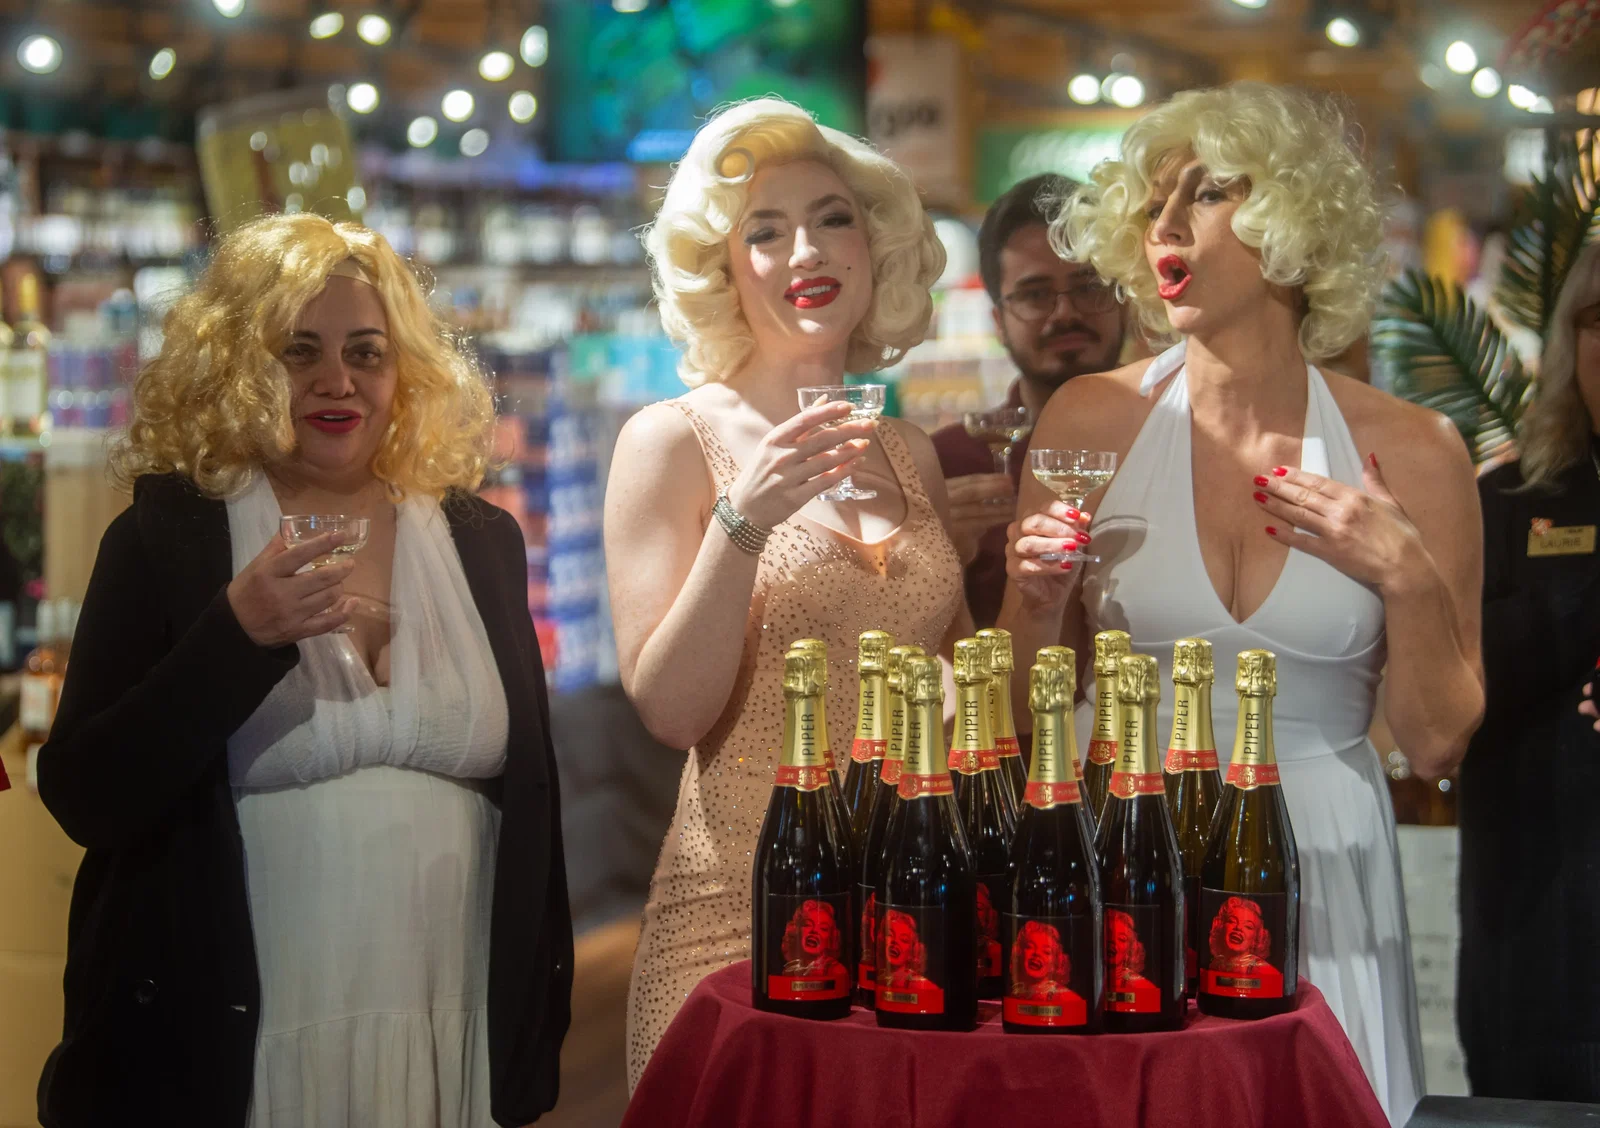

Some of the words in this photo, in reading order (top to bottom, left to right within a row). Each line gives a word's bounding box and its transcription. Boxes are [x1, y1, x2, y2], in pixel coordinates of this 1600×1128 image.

[861, 690, 875, 731] PIPER
[890, 709, 904, 751] PIPER
[964, 700, 979, 742] PIPER
[1098, 691, 1112, 732] PIPER
[1174, 699, 1189, 741] PIPER
[801, 713, 815, 756] PIPER
[907, 721, 921, 765] PIPER
[1039, 728, 1053, 772] PIPER
[1123, 720, 1138, 764] PIPER
[1243, 712, 1260, 755] PIPER
